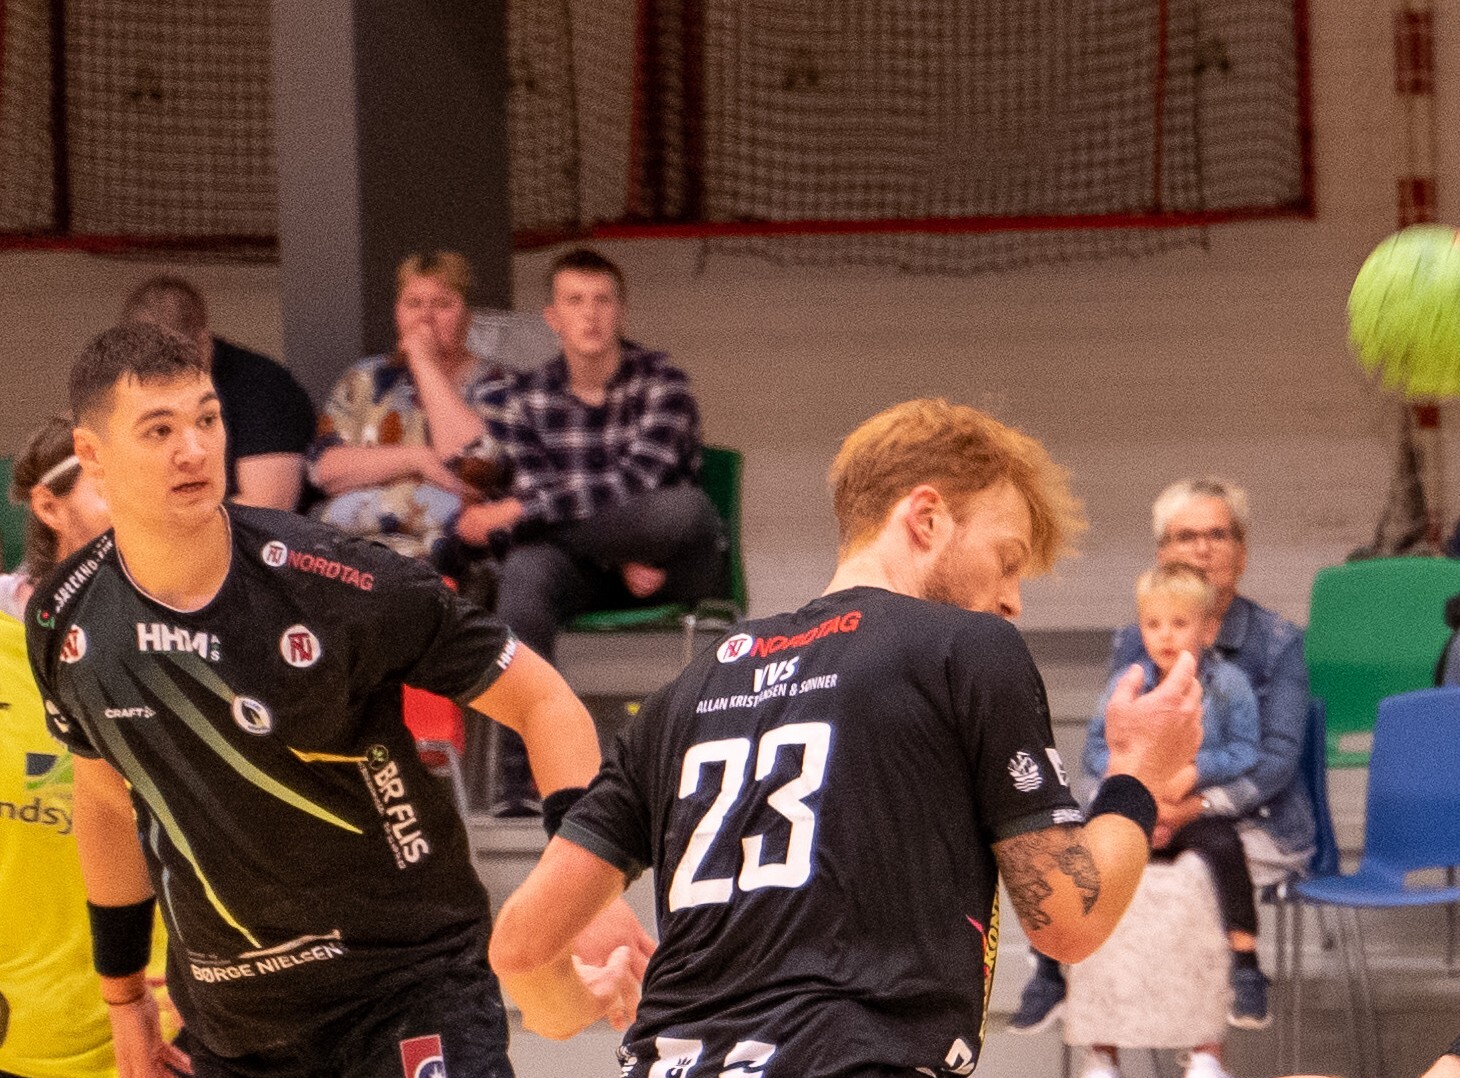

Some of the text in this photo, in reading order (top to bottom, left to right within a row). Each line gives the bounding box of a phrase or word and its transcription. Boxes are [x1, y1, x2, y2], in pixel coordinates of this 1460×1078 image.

[289, 549, 374, 591] NORDTAG
[136, 622, 208, 659] HHM
[696, 697, 728, 714] ALLAN
[789, 681, 798, 697] &
[799, 674, 838, 694] SØNNER
[753, 656, 800, 693] VVS
[104, 707, 144, 719] CRAFT
[374, 760, 405, 803] BR
[386, 803, 430, 863] FLIS
[669, 722, 831, 913] 23
[190, 962, 256, 983] BØRGE
[255, 941, 344, 975] NIELSEN
